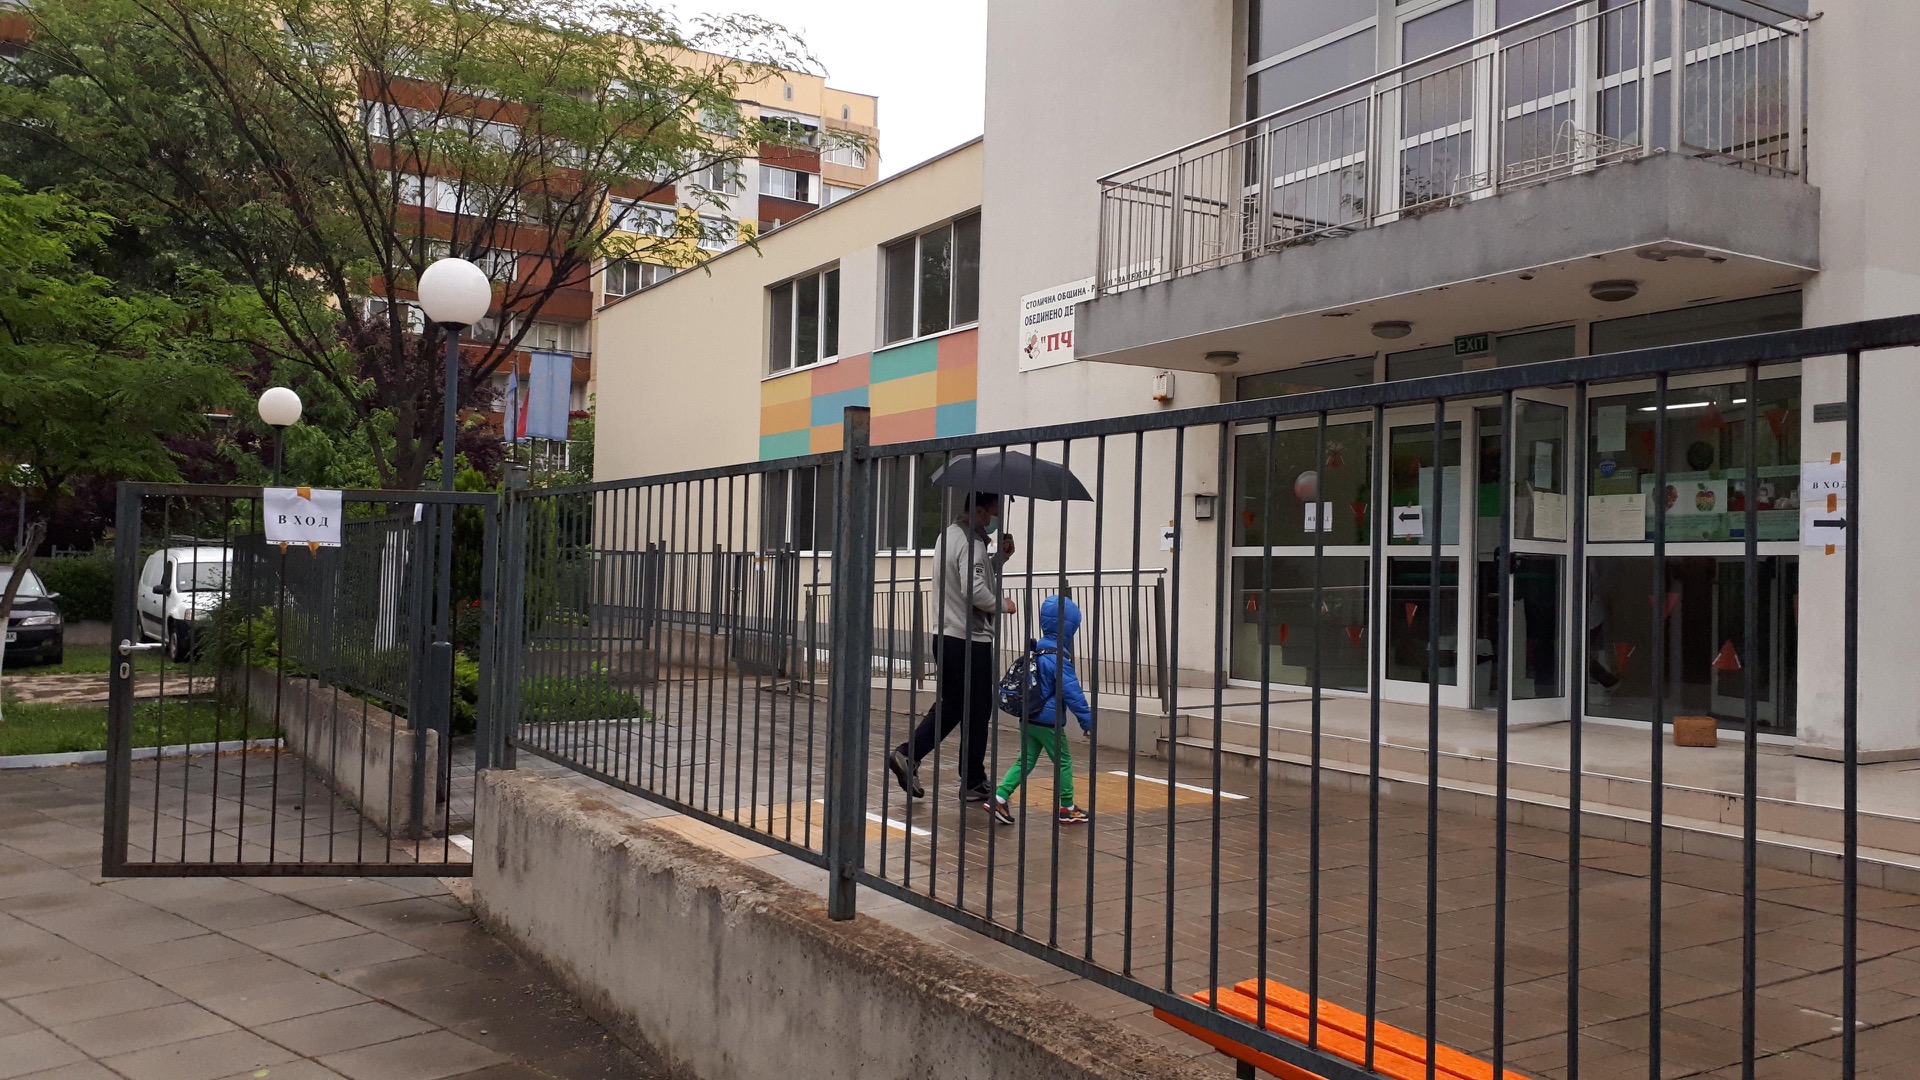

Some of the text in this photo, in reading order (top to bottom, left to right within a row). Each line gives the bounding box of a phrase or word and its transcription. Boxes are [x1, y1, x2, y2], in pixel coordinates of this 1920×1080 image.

[1026, 294, 1056, 309] СТОЛИЧНА
[1025, 304, 1075, 326] ОБЕДИНЕНО ДЕ
[1041, 330, 1074, 352] "ПЧ
[1458, 337, 1486, 352] EXIT
[278, 514, 329, 527] ВХОД
